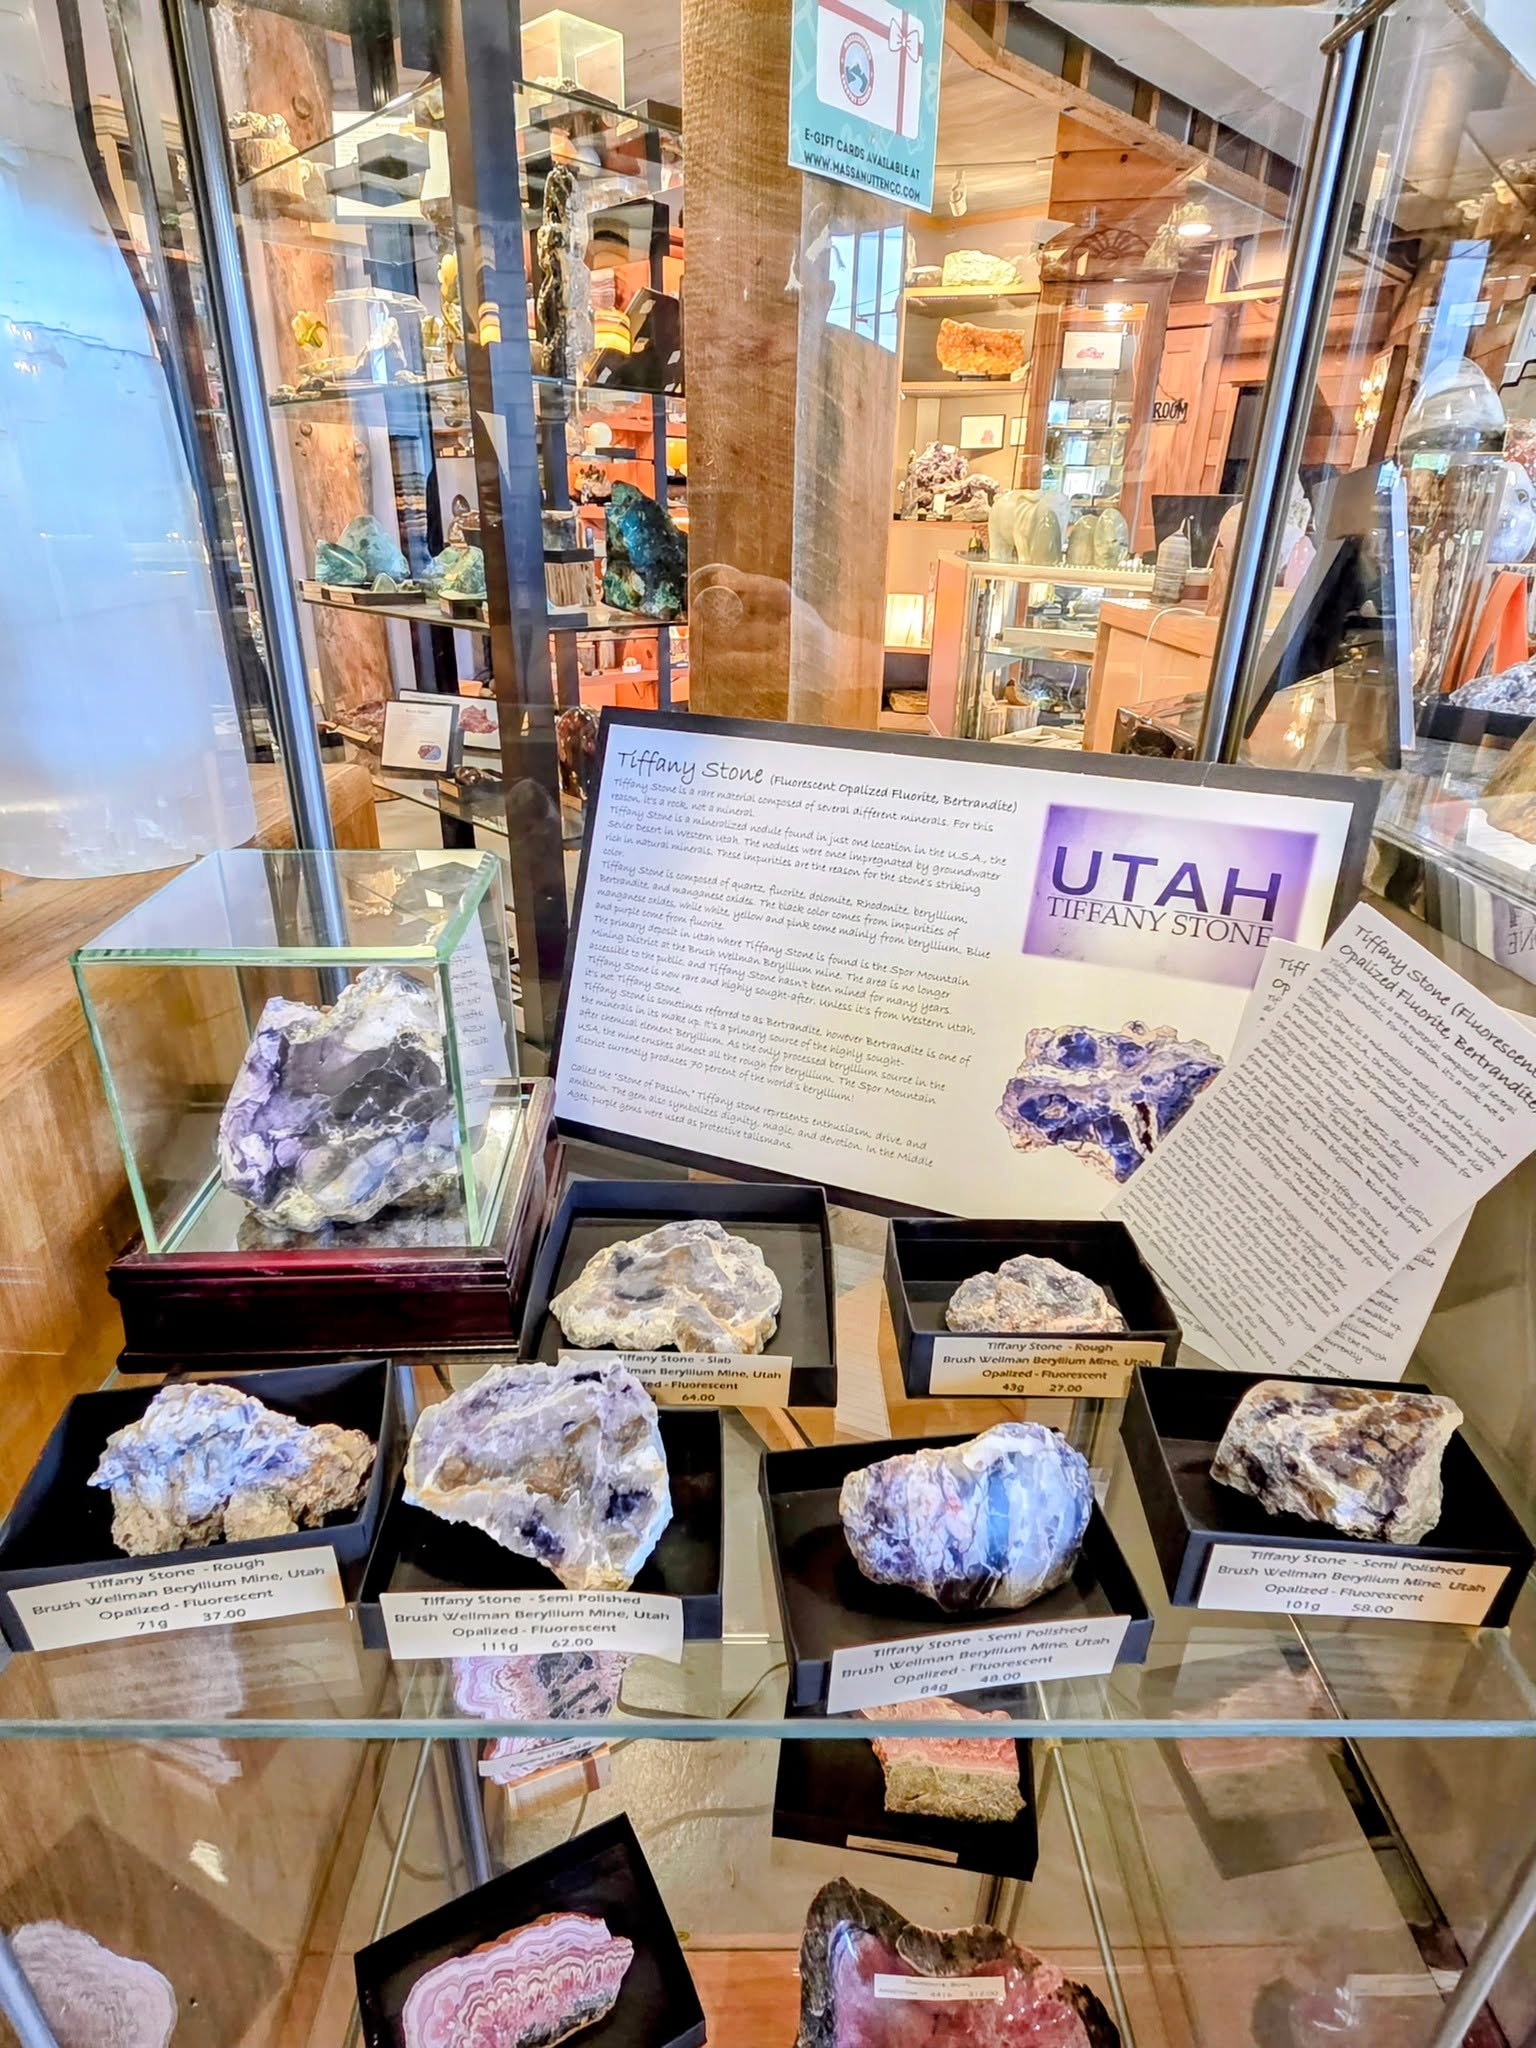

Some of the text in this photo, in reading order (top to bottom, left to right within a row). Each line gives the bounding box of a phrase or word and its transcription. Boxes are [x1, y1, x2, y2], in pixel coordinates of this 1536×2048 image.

[805, 128, 920, 179] E-GIFT CARDS AVAILABLE AT
[804, 151, 920, 200] WWW.MASSANUTTENCC.COM
[1153, 401, 1188, 420] ROOM
[617, 749, 1017, 813] Tiffany Stone (Fluorescent Opalized Fluorite, Bertrandite)
[614, 777, 648, 794] Tiffany
[650, 783, 677, 793] Stone
[678, 785, 687, 794] is
[697, 789, 715, 798] rare
[717, 792, 756, 802] material
[757, 796, 802, 808] composed
[804, 799, 816, 812] of
[817, 803, 850, 814] several
[853, 806, 897, 820] different
[953, 819, 970, 828] For
[973, 822, 994, 832] this
[610, 805, 644, 821] Tiffany
[646, 810, 673, 821] Stone
[674, 814, 682, 822] is
[693, 816, 748, 830] mineralized
[750, 824, 782, 836] nodule
[784, 826, 814, 839] found
[816, 832, 827, 841] in
[829, 832, 849, 846] just
[851, 838, 869, 847] one
[871, 839, 912, 852] location
[914, 844, 927, 854] in
[929, 847, 945, 857] the
[990, 855, 1007, 866] the
[1052, 846, 1282, 921] UTAH
[1048, 896, 1274, 947] TIFFANY STONE
[594, 914, 970, 986] The primary deposit in Utah where Tiffany Stone is found is the Spor Mountain
[1280, 958, 1310, 977] Tiff
[1355, 924, 1408, 976] Tiffany
[1406, 969, 1451, 1006] Stone
[585, 968, 598, 977] it's
[617, 974, 652, 991] Tiffany
[1339, 944, 1399, 992] Opalized
[1396, 988, 1451, 1039] Fluorite,
[987, 1342, 1113, 1353] Tiffany Stone Rough
[625, 1366, 781, 1378] lman Beryllium Mine, Utah
[982, 1369, 1107, 1379] Opalized Fluorescent
[1033, 1356, 1086, 1366] Beryllium
[1124, 1358, 1152, 1367] Utah
[671, 1381, 737, 1390] Fluorescent
[1002, 1383, 1082, 1393] 43g 27.00
[87, 1559, 264, 1589] Tiffany Stone Rough
[1251, 1551, 1465, 1575] Tiffany Stone Semi Polished
[32, 1568, 324, 1614] Brush Wellman Beryllium Mine, Utah
[1218, 1565, 1258, 1575] Brush
[1264, 1568, 1327, 1579] Wellman
[1331, 1572, 1399, 1584] Beryllium
[1448, 1582, 1485, 1592] Utah
[99, 1589, 272, 1620] Opalized Fluorescent
[421, 1593, 640, 1606] Tiffany Stone Semi Polished
[1265, 1583, 1424, 1602] Opalized Fluorescent
[137, 1608, 246, 1629] 71g 37.00
[394, 1609, 669, 1622] Brush Wellman Beryllium Mine, Utah
[1286, 1600, 1393, 1613] 101g 58.00
[452, 1625, 616, 1638] Opalized Fluorescent
[873, 1625, 1088, 1657] Tiffany Stone Semi Polished
[482, 1638, 593, 1652] 111g 62.00
[842, 1664, 884, 1678] Brush
[889, 1654, 954, 1670] Wellman
[959, 1646, 1026, 1660] Beryllium
[1075, 1637, 1110, 1646] Utah
[894, 1655, 1052, 1684] Opalized Fluorescent
